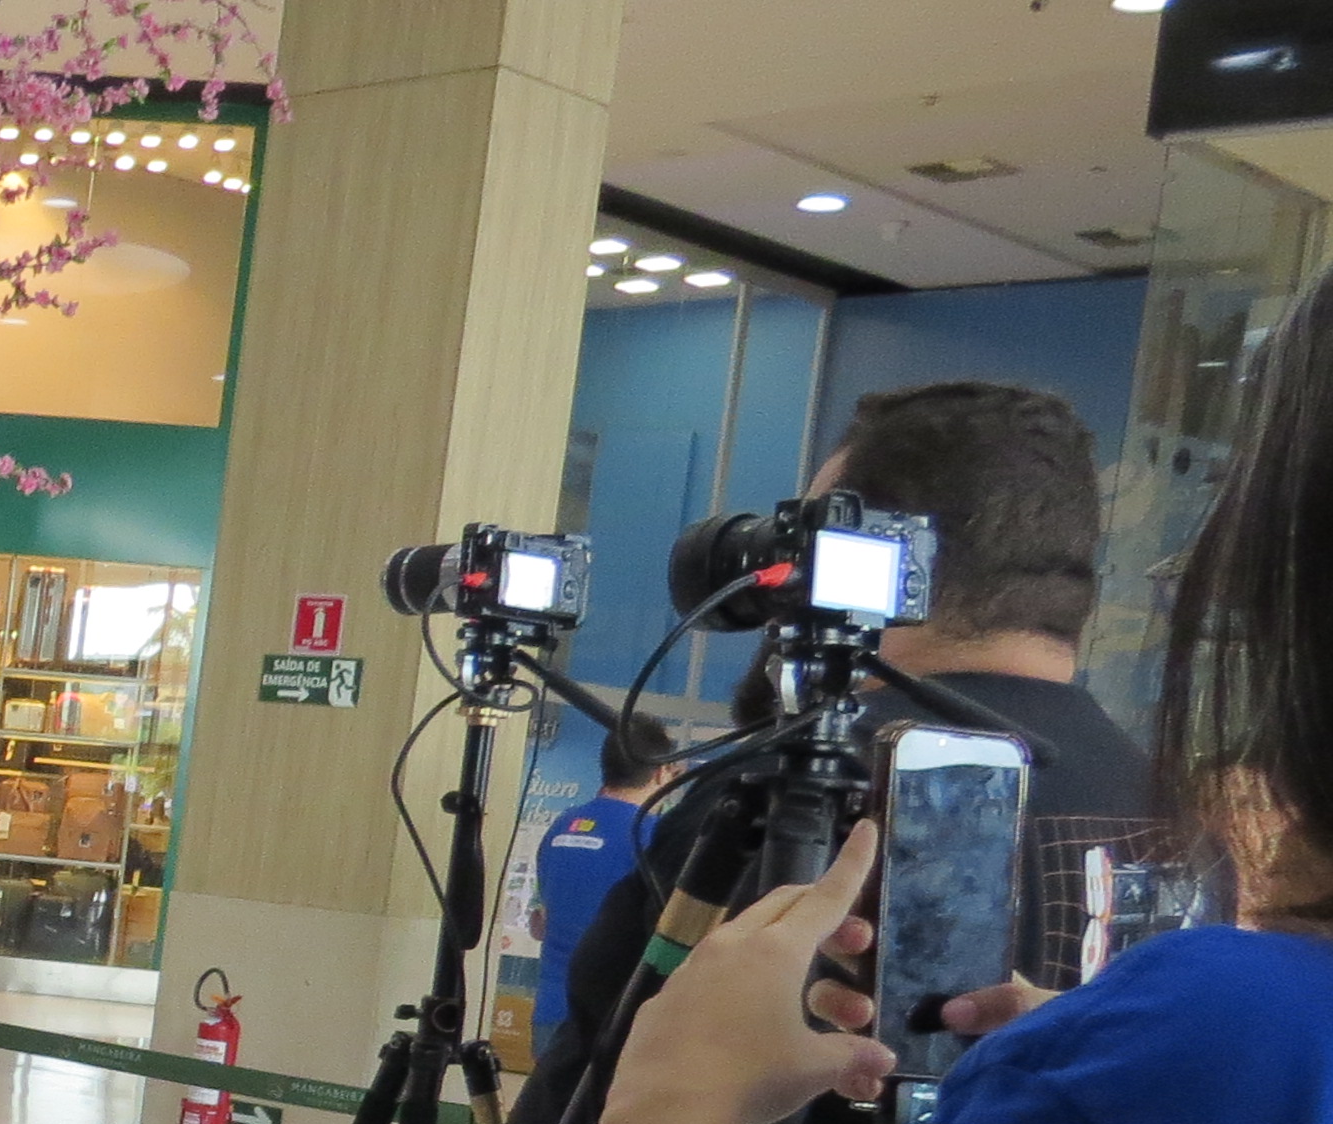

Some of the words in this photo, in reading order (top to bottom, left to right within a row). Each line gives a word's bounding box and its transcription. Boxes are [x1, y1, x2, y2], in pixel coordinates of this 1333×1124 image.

[273, 657, 305, 672] SAÍDA
[306, 661, 321, 672] DE
[262, 673, 329, 688] EMERGÊNCIA
